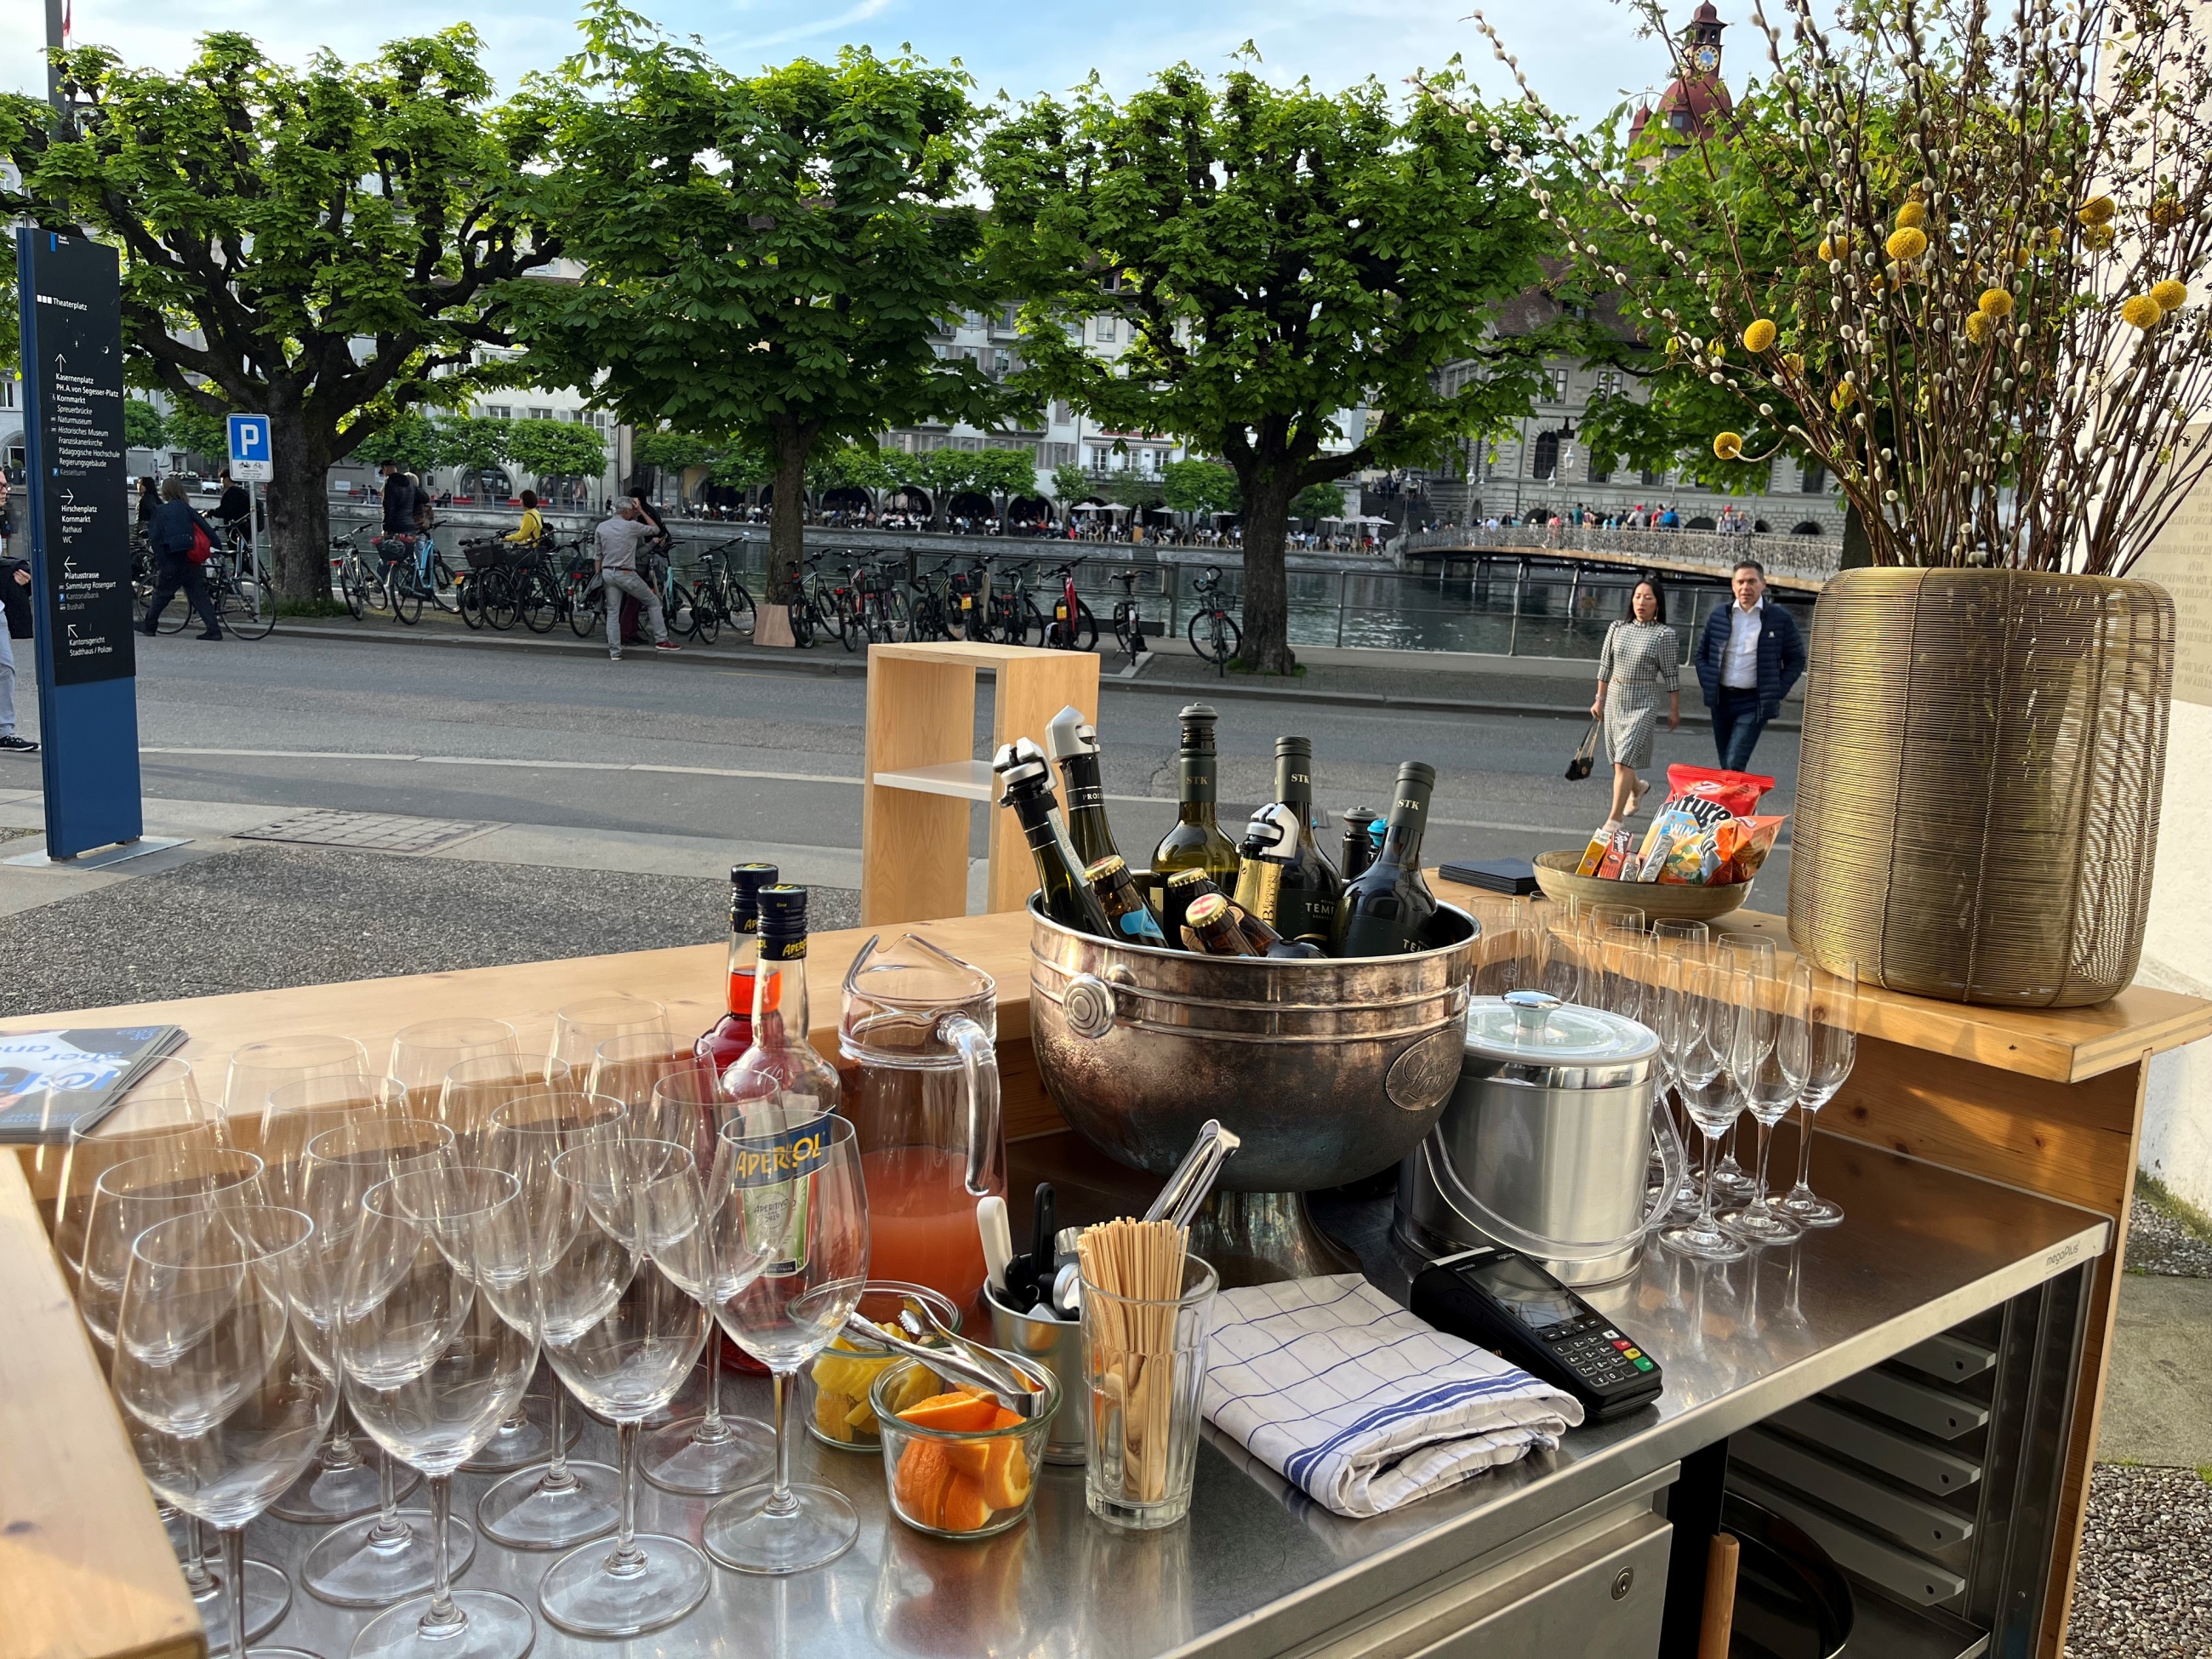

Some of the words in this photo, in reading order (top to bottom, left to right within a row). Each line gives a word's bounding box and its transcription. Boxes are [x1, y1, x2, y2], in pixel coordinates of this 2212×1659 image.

[53, 297, 88, 311] Theaterplatz
[55, 373, 94, 385] Kasernenplatz
[83, 386, 119, 398] Segesser-Platz
[56, 394, 86, 404] Kornmarkt
[57, 404, 93, 415] Spreuerbrücke
[57, 415, 93, 425] Naturmuseum
[58, 425, 87, 436] Historisches
[88, 428, 109, 437] Museum
[58, 436, 103, 448] Franziskanerkirche
[240, 424, 259, 456] P
[59, 447, 93, 458] Pädagogische
[93, 449, 121, 459] Hochschule
[59, 457, 107, 468] Regierungsgebäude
[60, 468, 87, 477] Kesselturm
[61, 505, 98, 514] Hirschenplatz
[65, 571, 100, 580] Pilatusstrasse
[65, 582, 92, 591] Sammlung
[92, 580, 117, 590] Rosengart
[69, 636, 105, 647] Kantonsgericht
[69, 648, 94, 657] Stadthaus
[98, 645, 113, 653] Polizei
[1186, 775, 1208, 786] STK
[1291, 773, 1310, 784] STK
[1397, 799, 1420, 811] STK
[1669, 823, 1696, 836] WIN
[1263, 874, 1273, 909] EDOUARD
[735, 1132, 822, 1180] APEROL
[754, 1198, 790, 1214] APERITIVO
